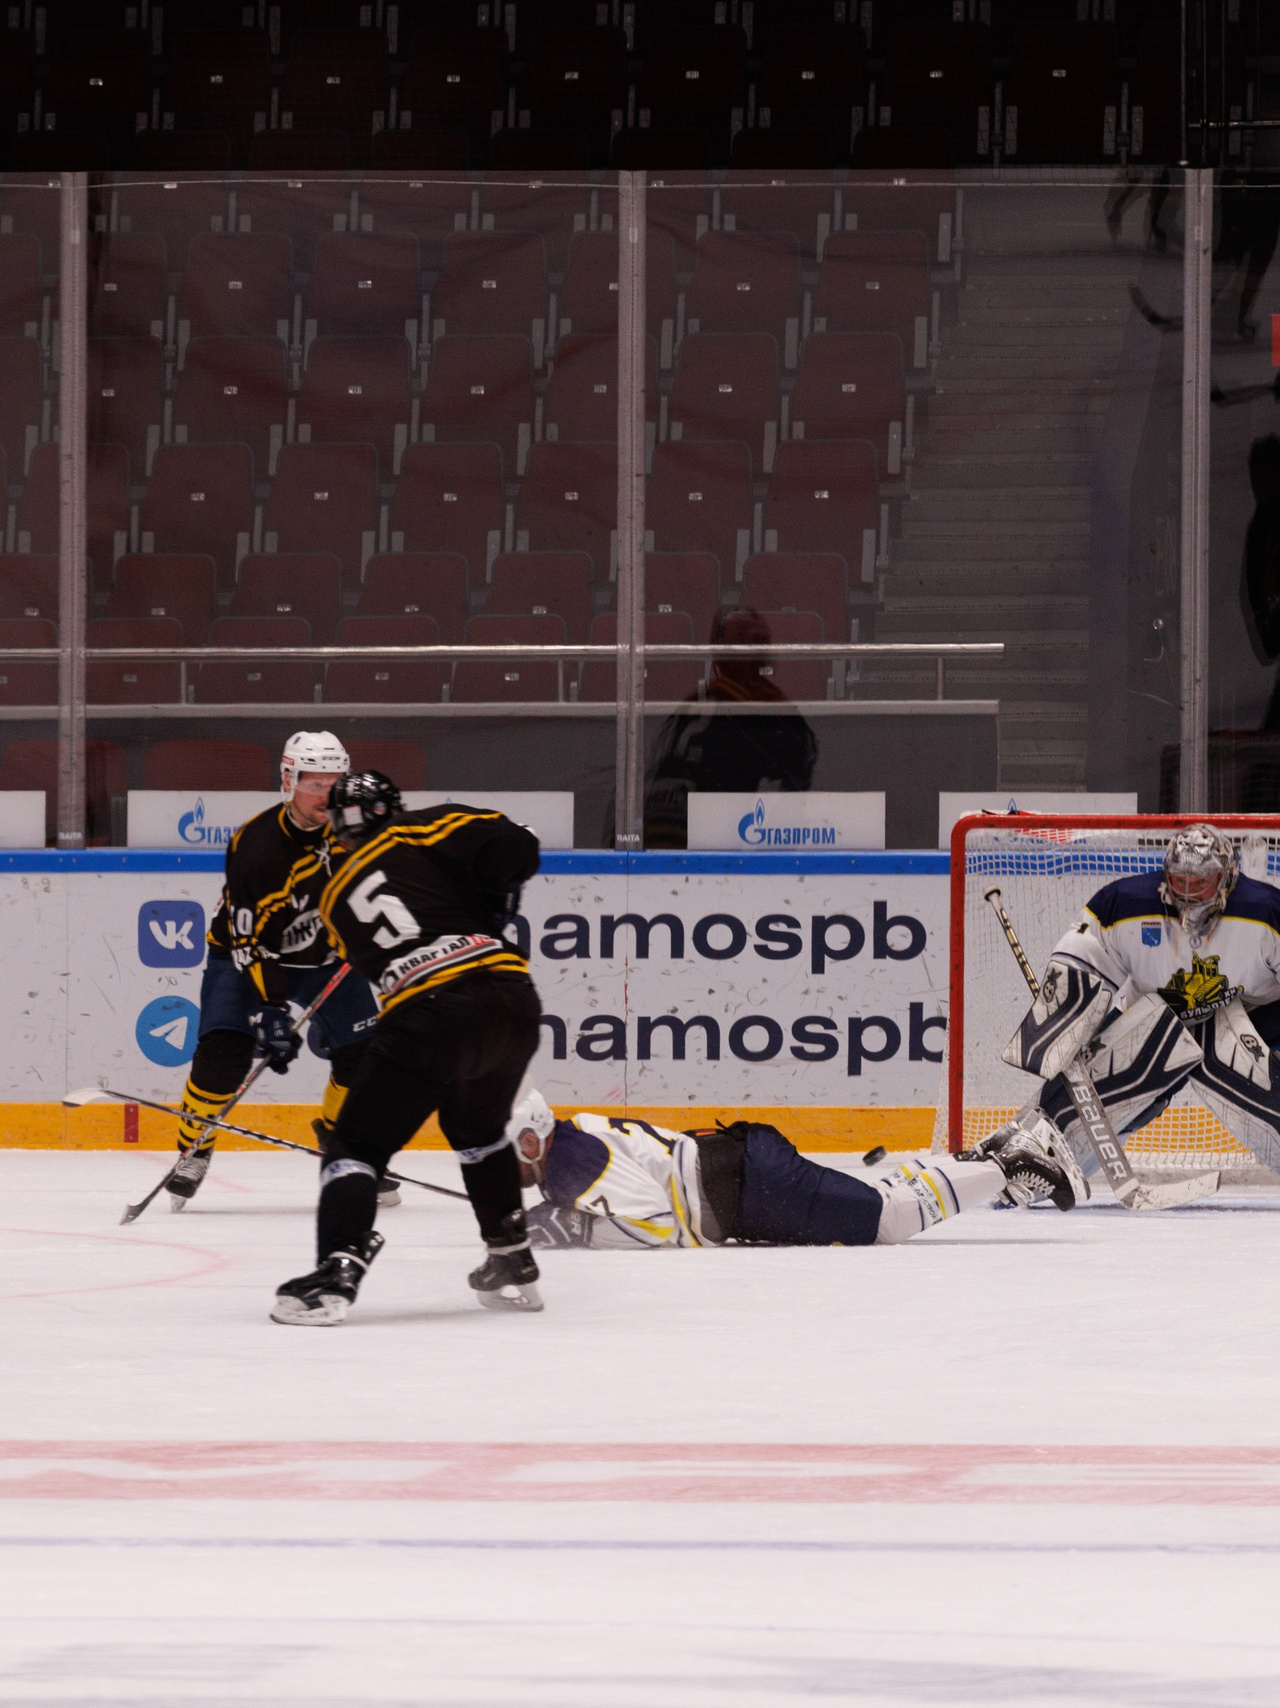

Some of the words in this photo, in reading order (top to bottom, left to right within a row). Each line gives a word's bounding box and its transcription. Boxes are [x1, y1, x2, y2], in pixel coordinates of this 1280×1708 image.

[616, 833, 641, 843] RAITA
[766, 827, 836, 846] ГАЗПРОМ
[346, 869, 422, 949] 5
[149, 920, 195, 949] VK
